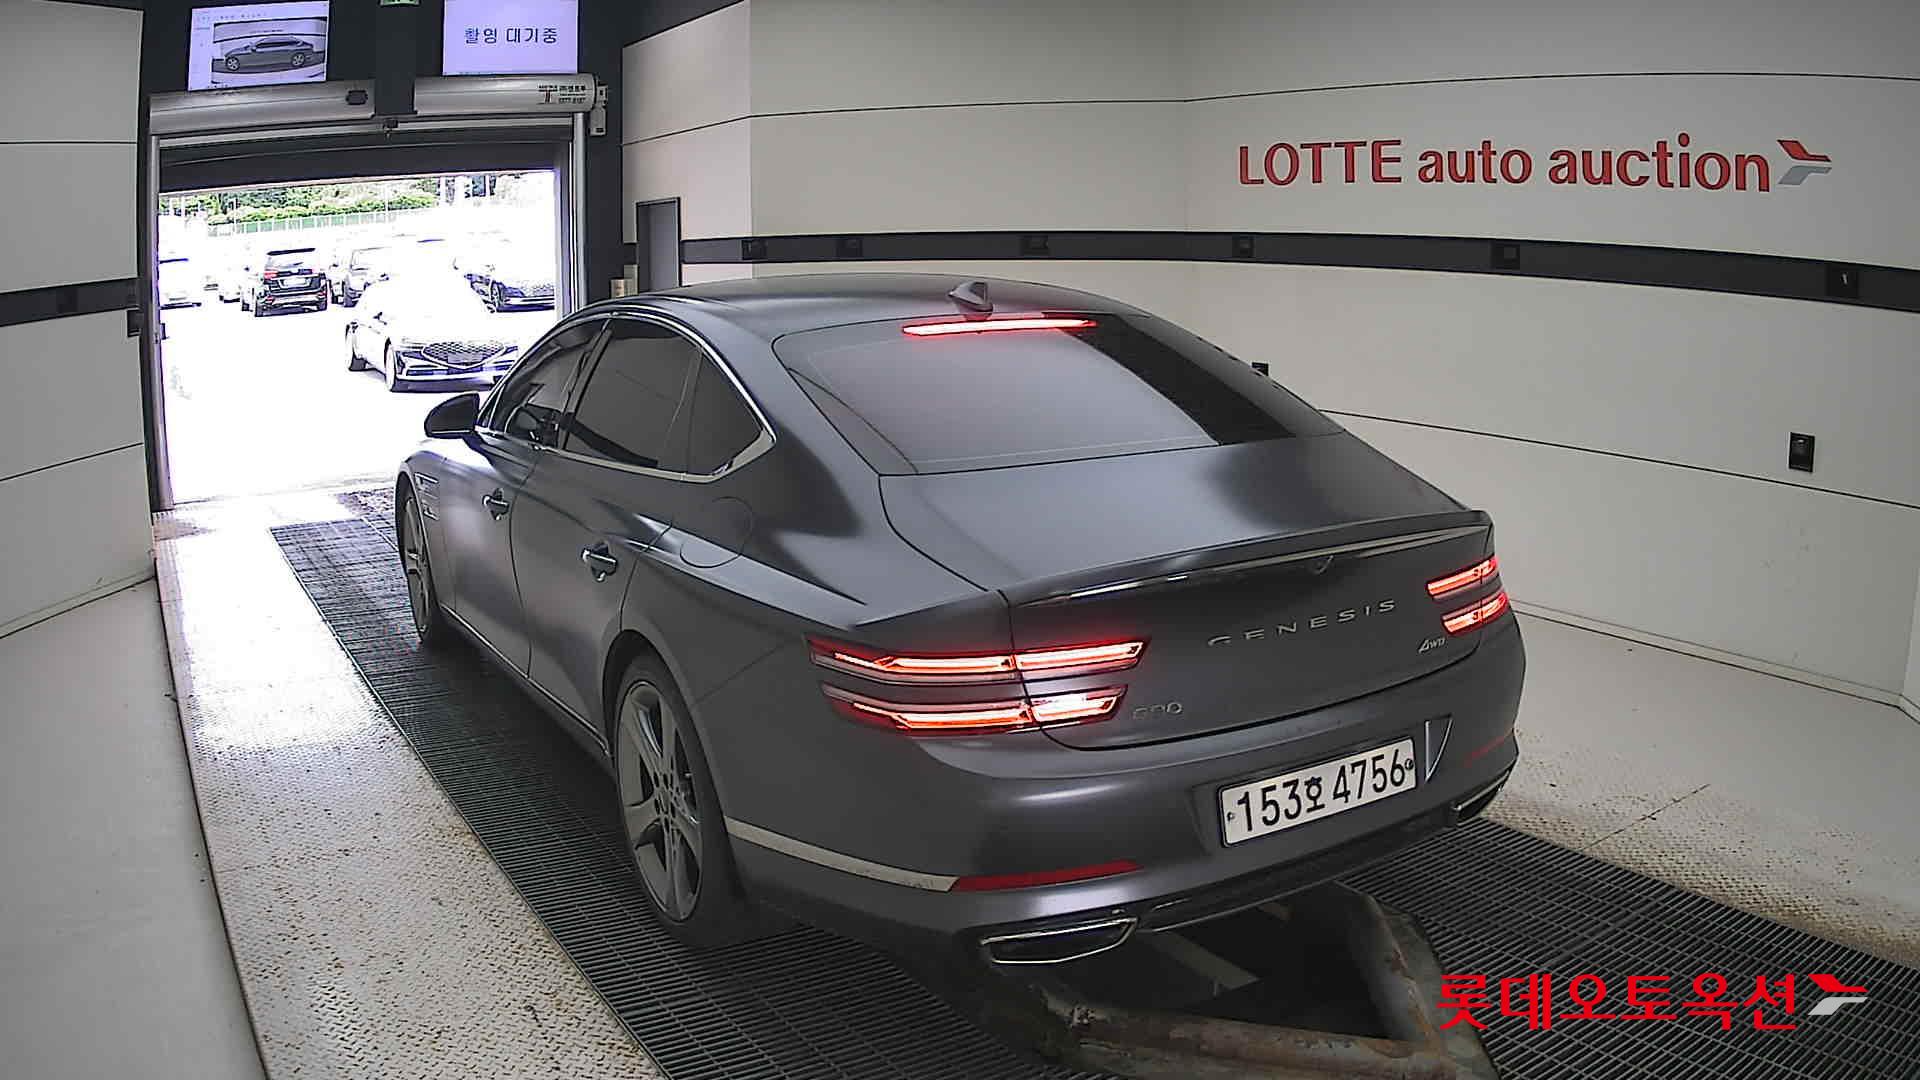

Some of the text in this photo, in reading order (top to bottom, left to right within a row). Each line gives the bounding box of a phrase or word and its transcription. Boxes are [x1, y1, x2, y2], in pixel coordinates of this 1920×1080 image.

[506, 27, 558, 44] 대기중
[1239, 133, 1770, 192] LOTTE auto auction
[1207, 599, 1396, 648] GENESIS
[1333, 749, 1406, 803] 4756
